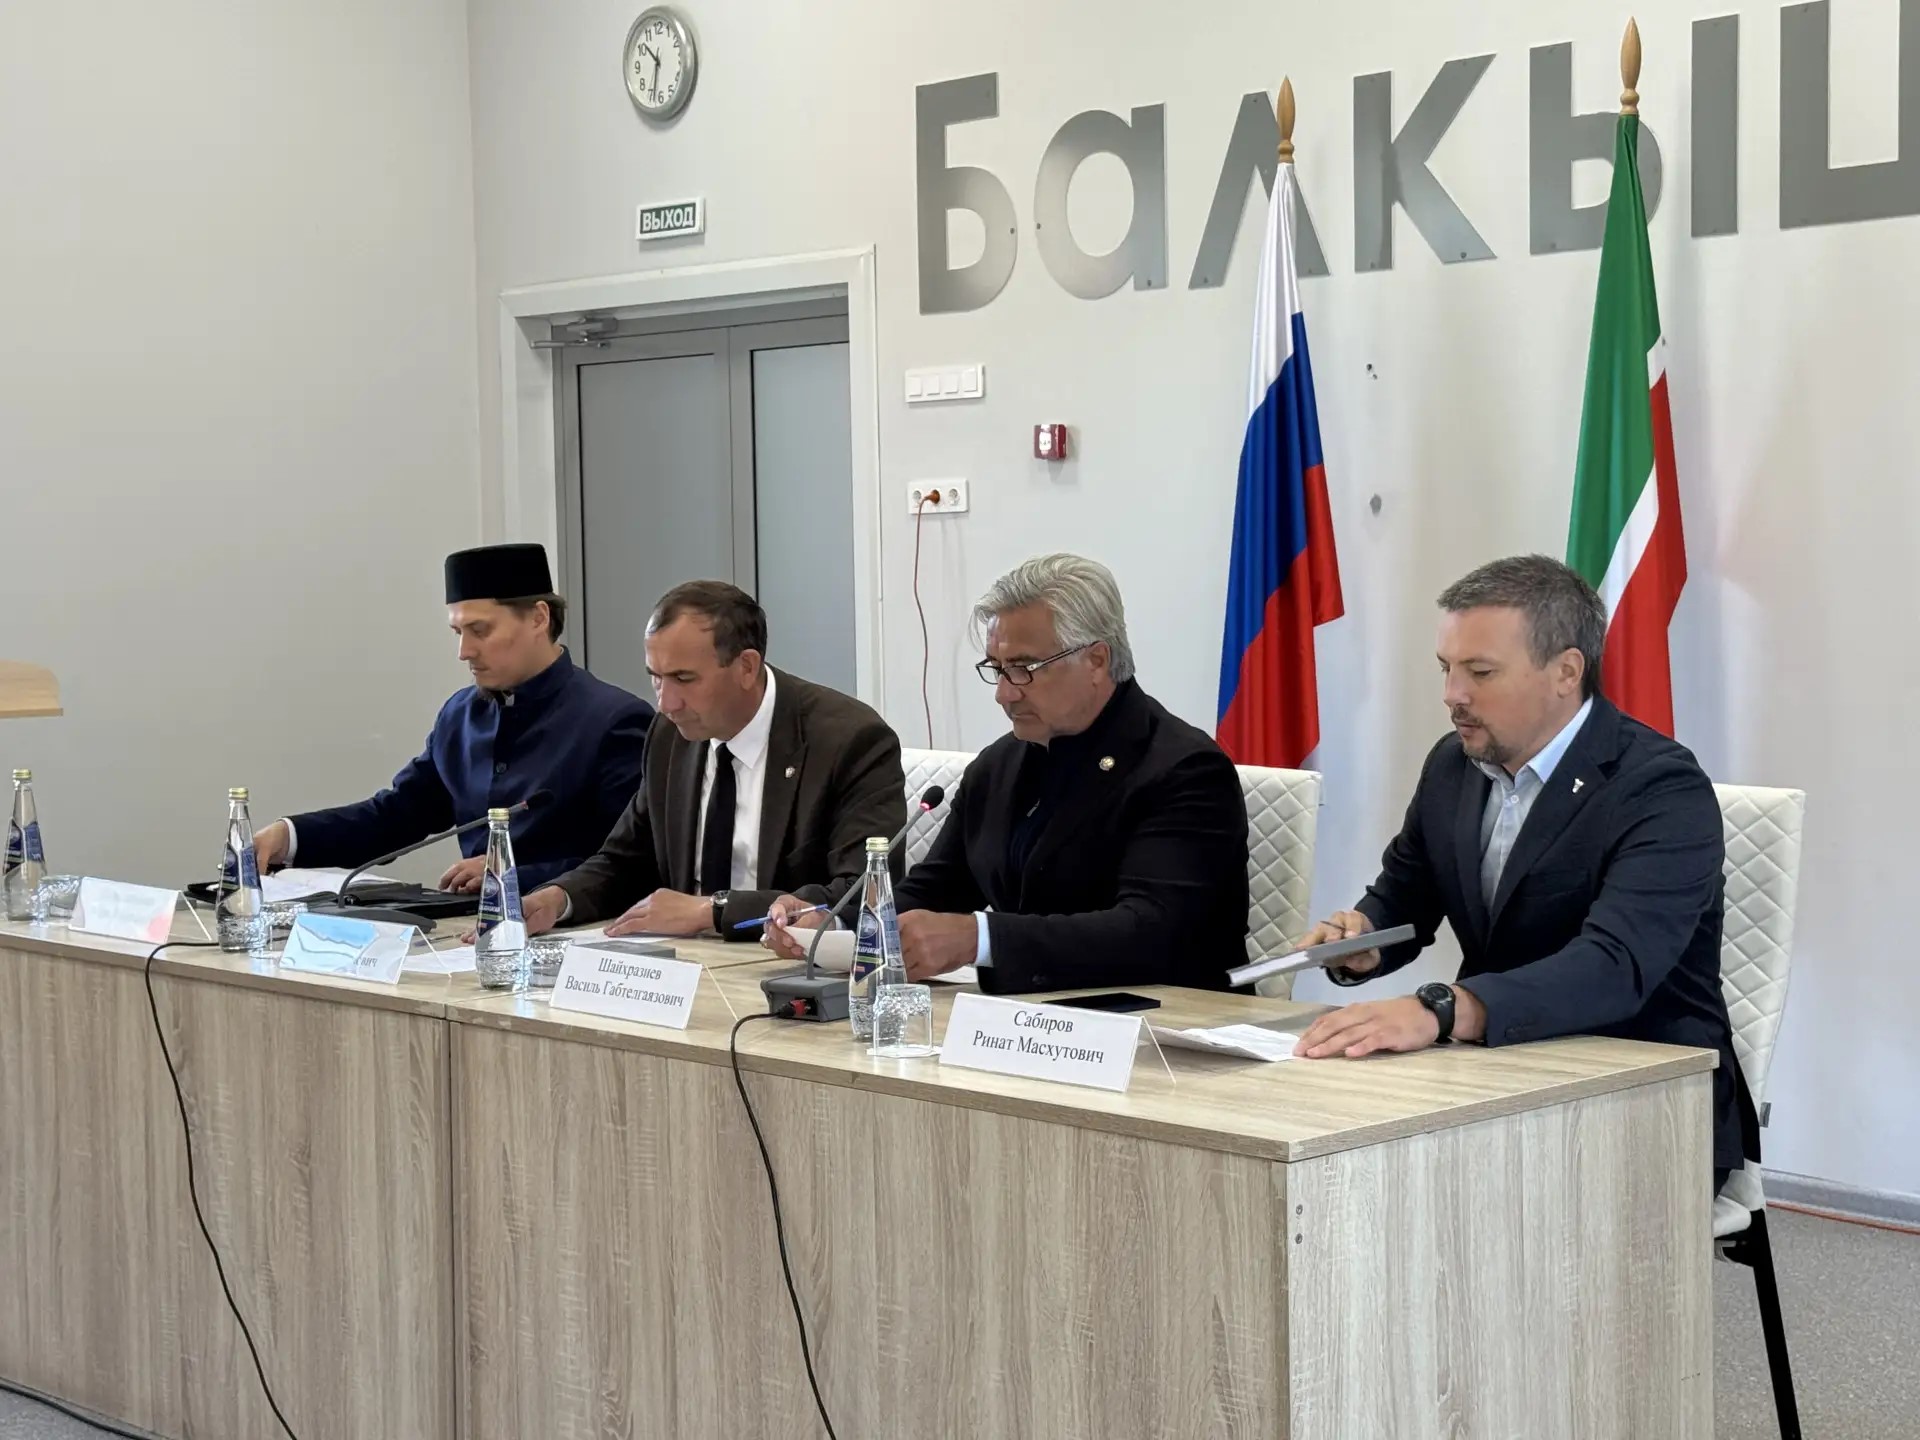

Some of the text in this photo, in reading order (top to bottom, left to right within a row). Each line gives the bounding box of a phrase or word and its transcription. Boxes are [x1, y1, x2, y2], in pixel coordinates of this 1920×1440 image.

[644, 28, 653, 42] 11
[653, 21, 664, 35] 12
[665, 24, 671, 38] 1
[637, 43, 648, 57] 10
[634, 60, 641, 74] 9
[639, 77, 646, 91] 8
[657, 90, 665, 104] 6
[642, 206, 694, 232] ВЫХОД
[564, 975, 685, 1007] Василь Габтелгаязович
[1013, 1010, 1074, 1035] Сабиров
[972, 1029, 1104, 1064] Ринат Масхутович
